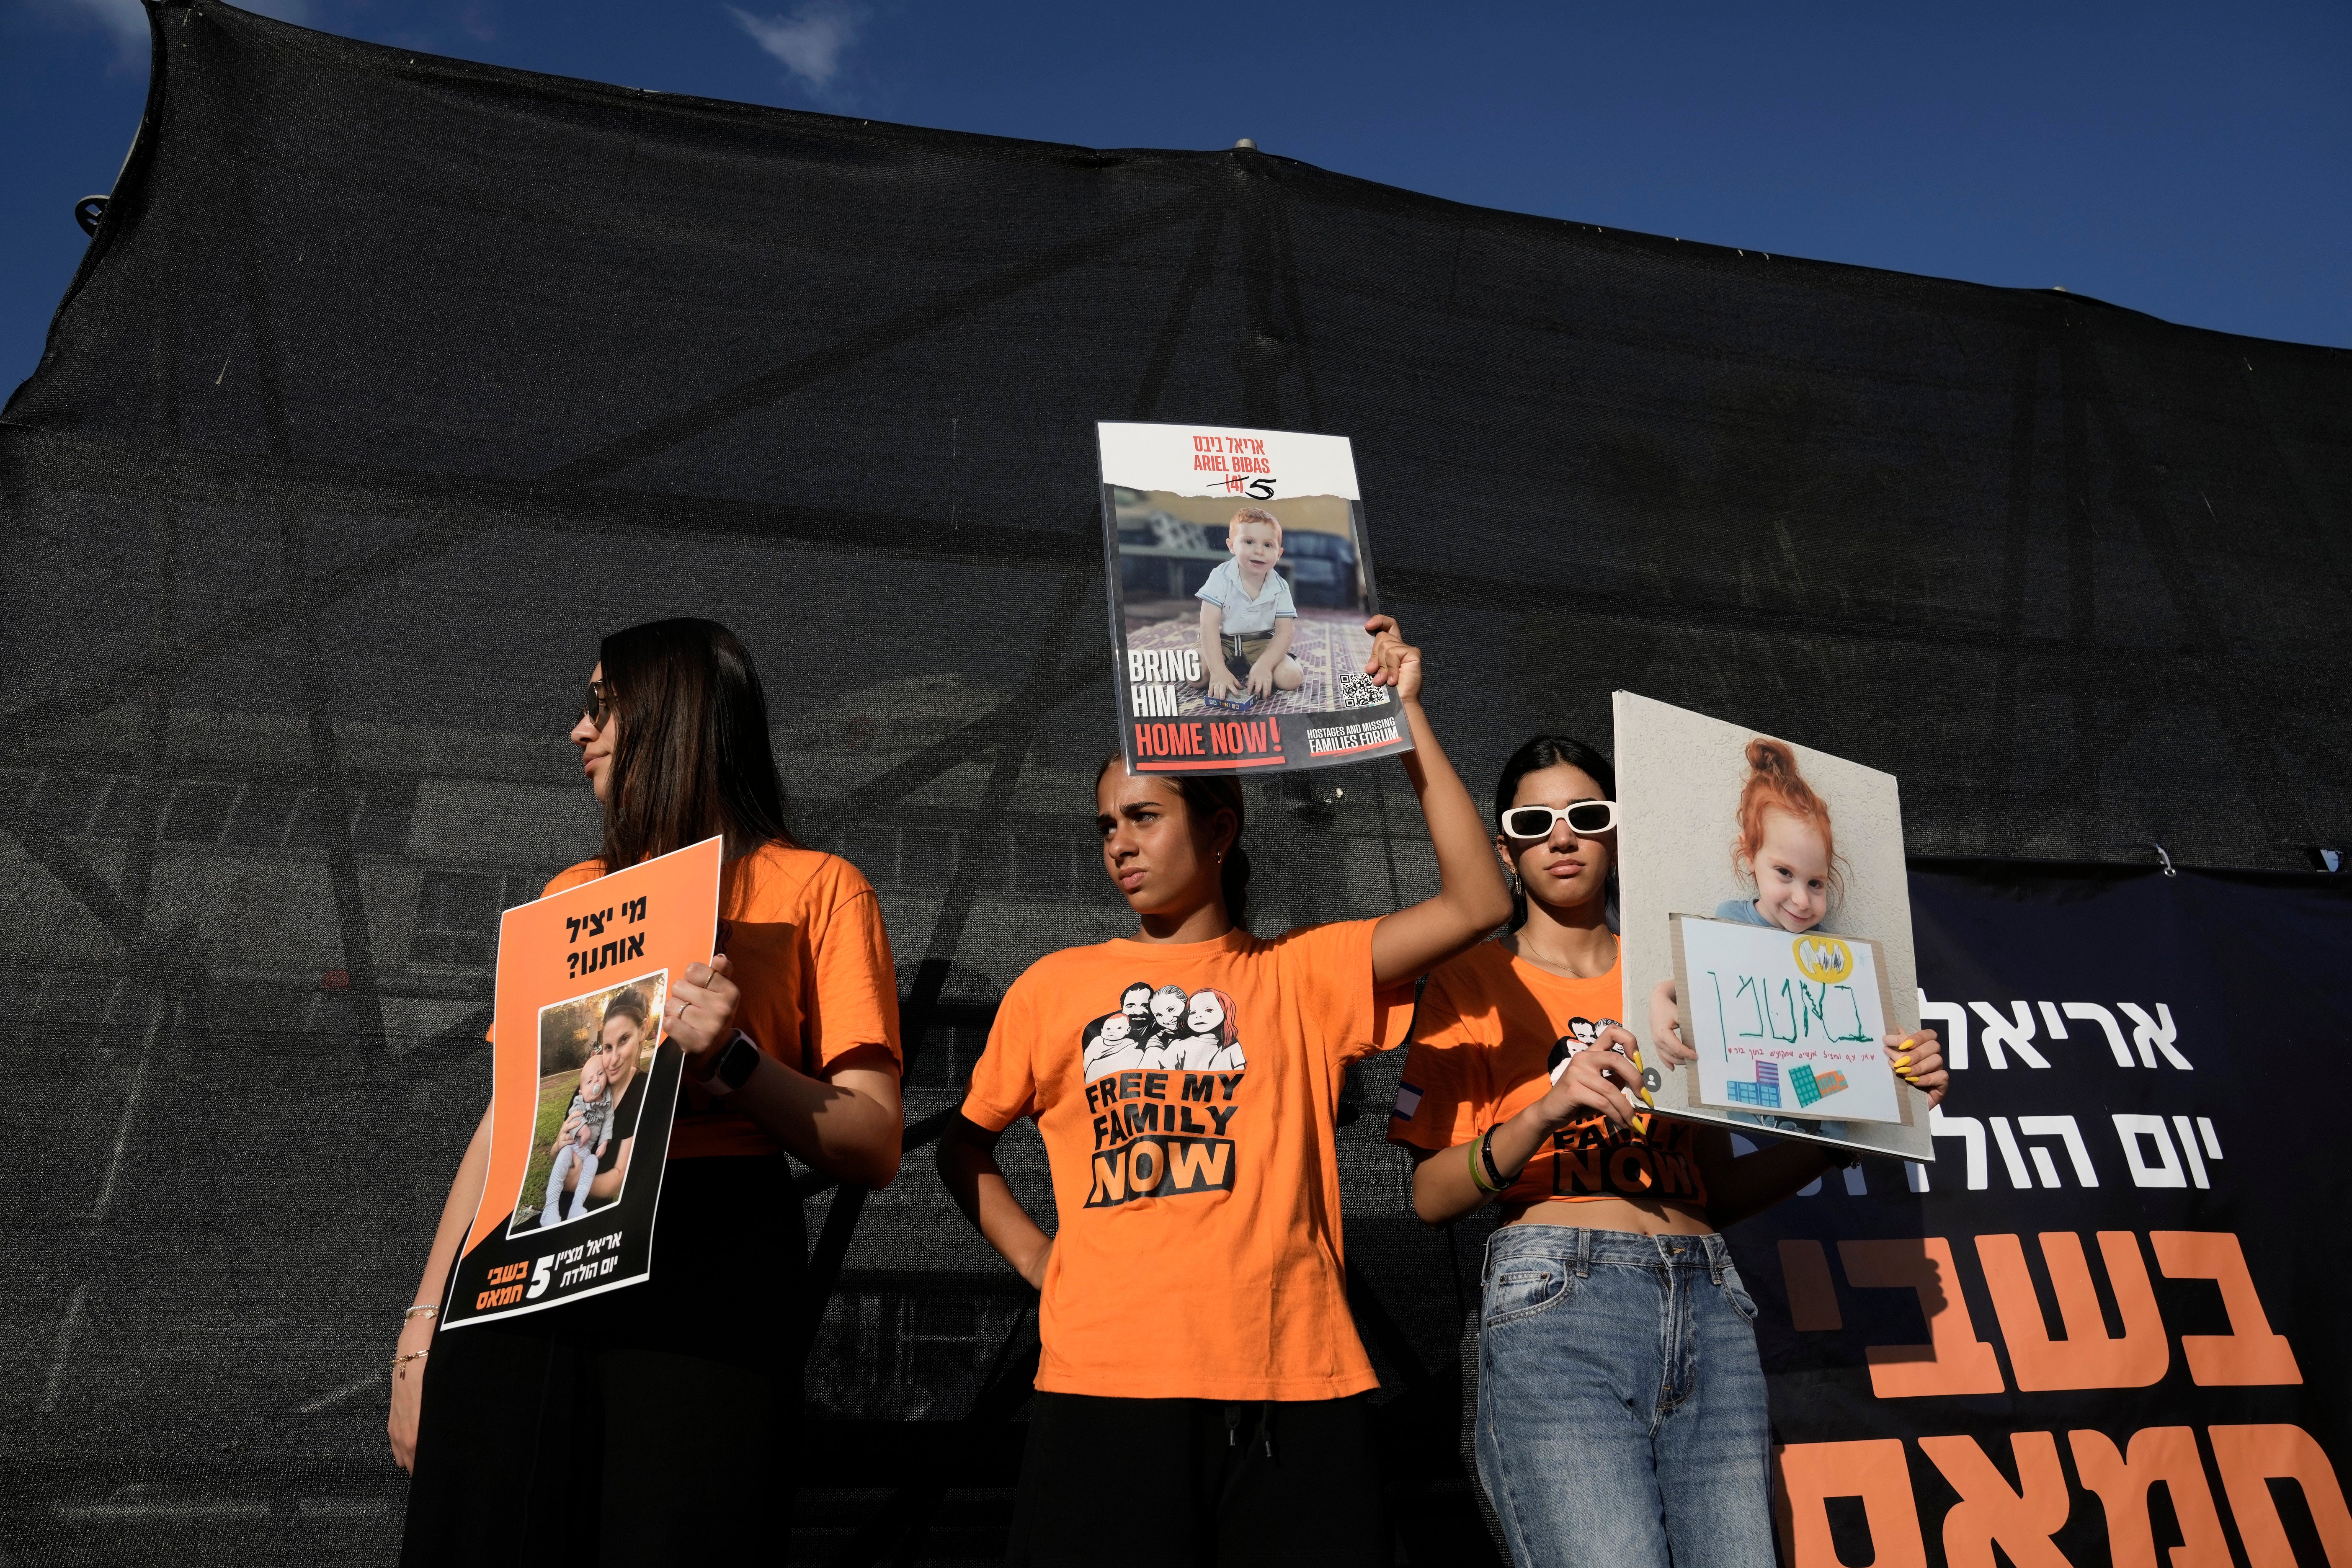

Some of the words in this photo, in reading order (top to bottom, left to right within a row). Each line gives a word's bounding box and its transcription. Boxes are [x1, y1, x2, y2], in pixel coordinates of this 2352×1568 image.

[1193, 436, 1223, 452] ביבס
[1225, 436, 1265, 455] אריאל
[1194, 455, 1230, 472] ARIEL
[1232, 456, 1270, 474] BIBAS
[1245, 478, 1277, 500] 5
[1127, 649, 1201, 682] BRING
[1130, 685, 1178, 717] HIM
[1135, 723, 1205, 756] HOME
[1210, 717, 1282, 754] NOW!
[1307, 726, 1345, 739] HOSTAGES
[1346, 724, 1362, 735] AND
[1362, 717, 1396, 732] MISSING
[1309, 734, 1359, 753] FAMILIES
[1358, 726, 1399, 747] FORUM
[566, 907, 614, 944] יציל
[622, 895, 647, 924] מי
[567, 932, 645, 979] אותנו?
[1917, 988, 2194, 1070] אריאל
[1085, 1072, 1168, 1114] FREE
[1181, 1074, 1245, 1102] MY
[1093, 1102, 1238, 1150] FAMILY
[2112, 1113, 2223, 1189] יום
[1090, 1141, 1230, 1203] NOW
[1559, 1147, 1693, 1194] NOW
[554, 1245, 584, 1271] מציין
[586, 1231, 622, 1257] אריאל
[487, 1261, 529, 1286] בשבי
[526, 1254, 555, 1299] 5
[560, 1261, 598, 1288] הולדת
[600, 1256, 618, 1276] יום
[476, 1284, 523, 1310] חמאס
[1777, 1230, 2304, 1399] בשבי
[1771, 1423, 2352, 1568] חמאס
